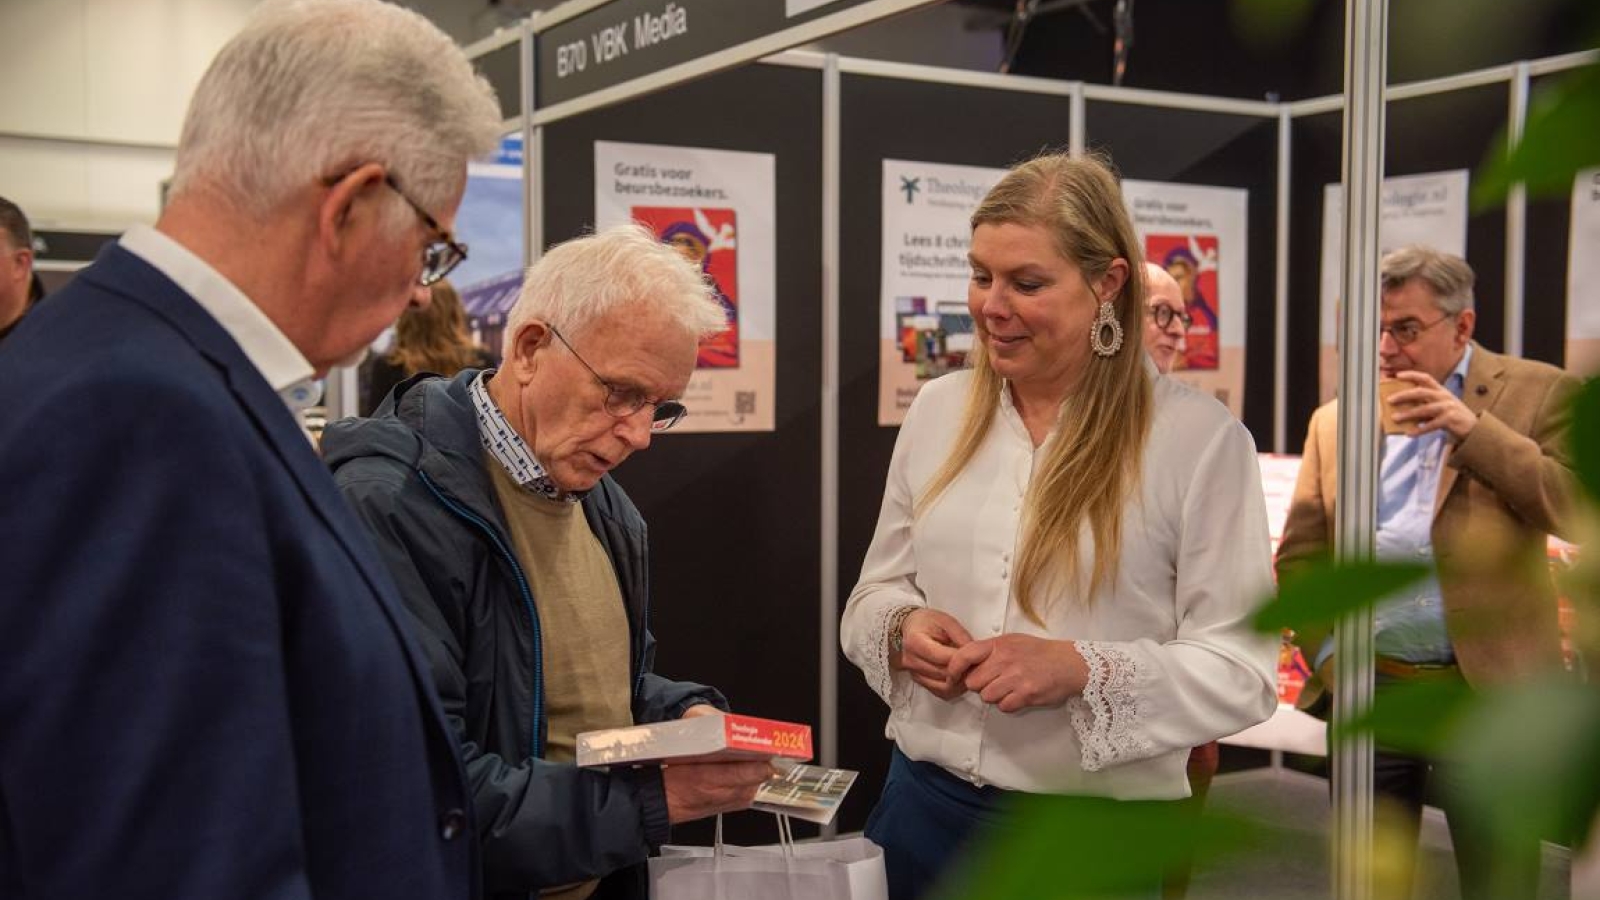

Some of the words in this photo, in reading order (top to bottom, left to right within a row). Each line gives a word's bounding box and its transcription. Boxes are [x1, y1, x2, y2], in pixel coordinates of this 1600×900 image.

[557, 40, 587, 78] B70
[591, 22, 628, 63] VBK
[634, 2, 687, 49] Media
[614, 162, 657, 178] Gratis
[661, 168, 692, 180] voor
[614, 180, 728, 200] beursbezoekers.
[903, 232, 932, 247] Lees
[772, 730, 806, 752] 2024
